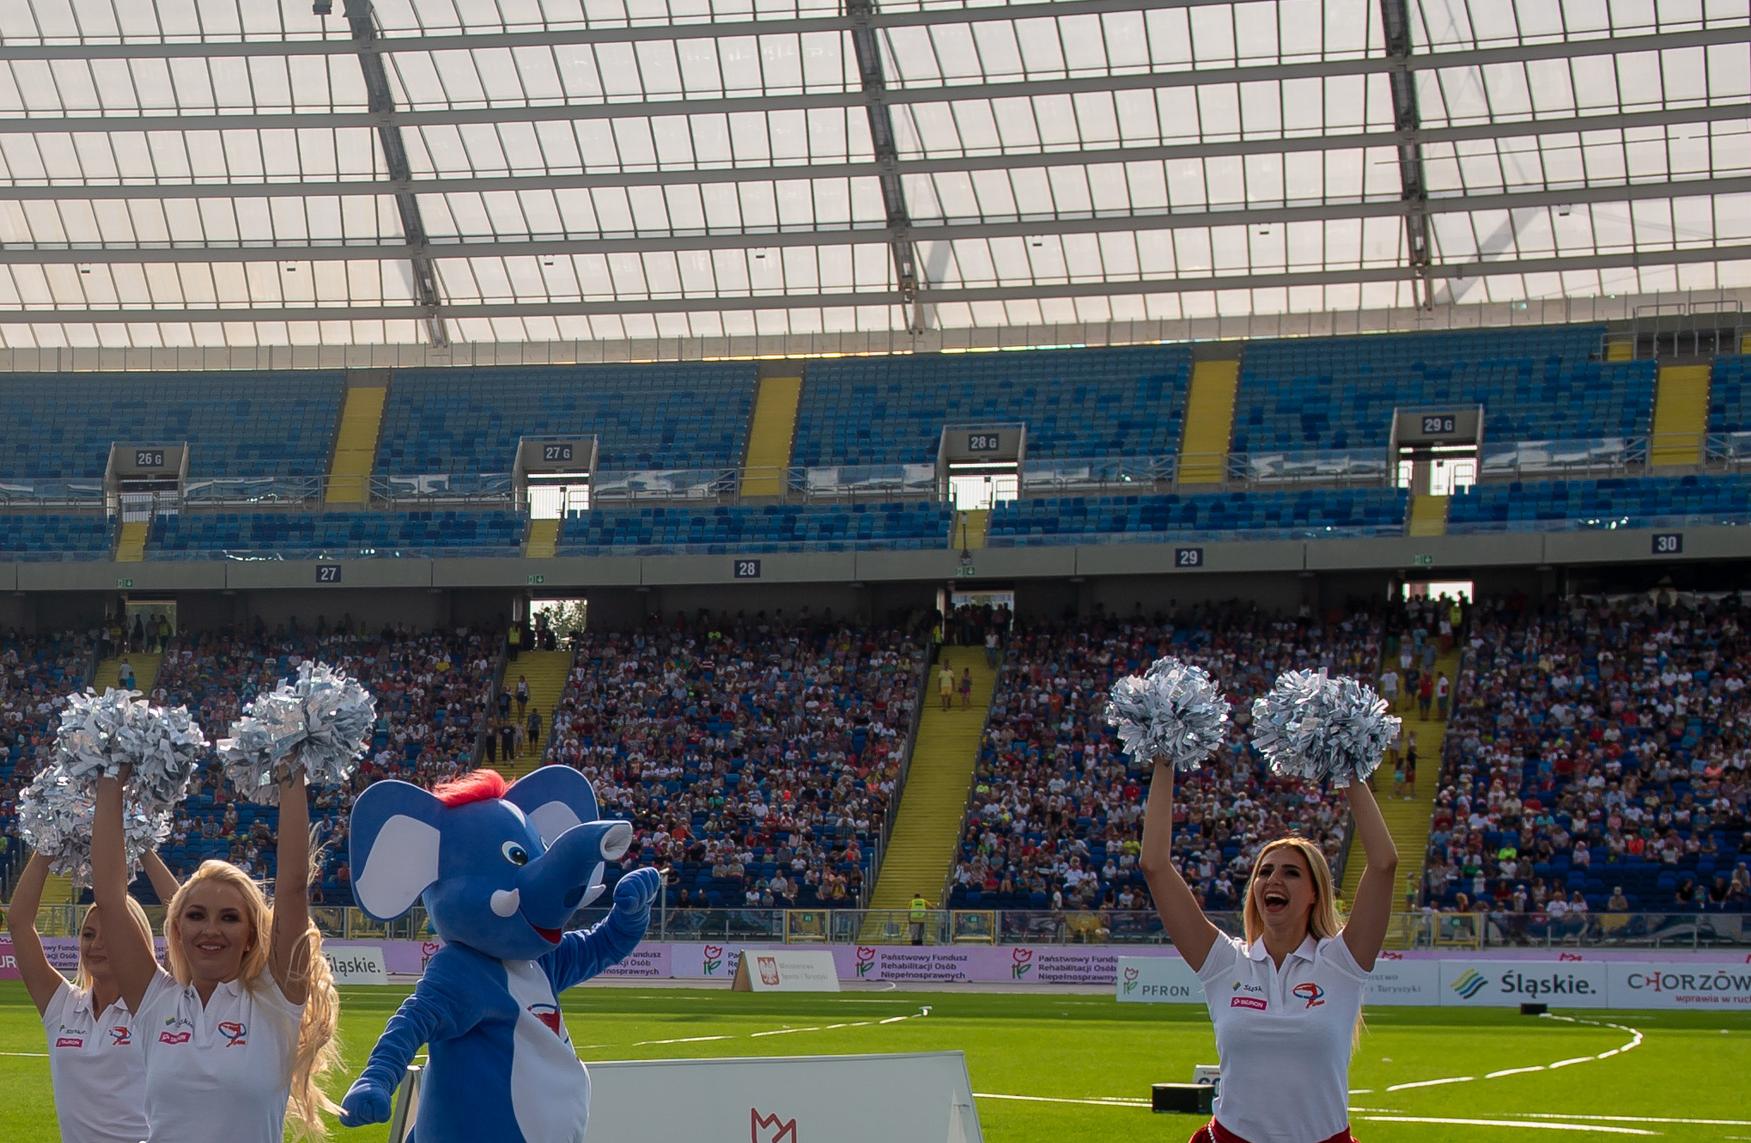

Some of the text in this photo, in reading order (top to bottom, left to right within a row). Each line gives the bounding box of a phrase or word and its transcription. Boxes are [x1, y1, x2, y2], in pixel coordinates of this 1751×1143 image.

[1425, 419, 1452, 433] 29 G
[971, 436, 997, 449] 28 G
[138, 452, 162, 465] 26 G
[546, 447, 571, 459] 27 G
[1658, 536, 1677, 551] 30
[1180, 550, 1198, 565] 29
[320, 567, 337, 581] 27
[738, 562, 755, 576] 28
[881, 953, 968, 962] Państwowy Fundusz
[1038, 954, 1118, 964] Państwowy Fundu
[881, 962, 957, 971] Rehabilitacji Osób
[1038, 963, 1117, 973] Rehabilitacji Osób
[881, 971, 966, 980] Niepełnosprawnych
[1501, 970, 1596, 998] Śląskie.
[1142, 985, 1190, 997] PFRON
